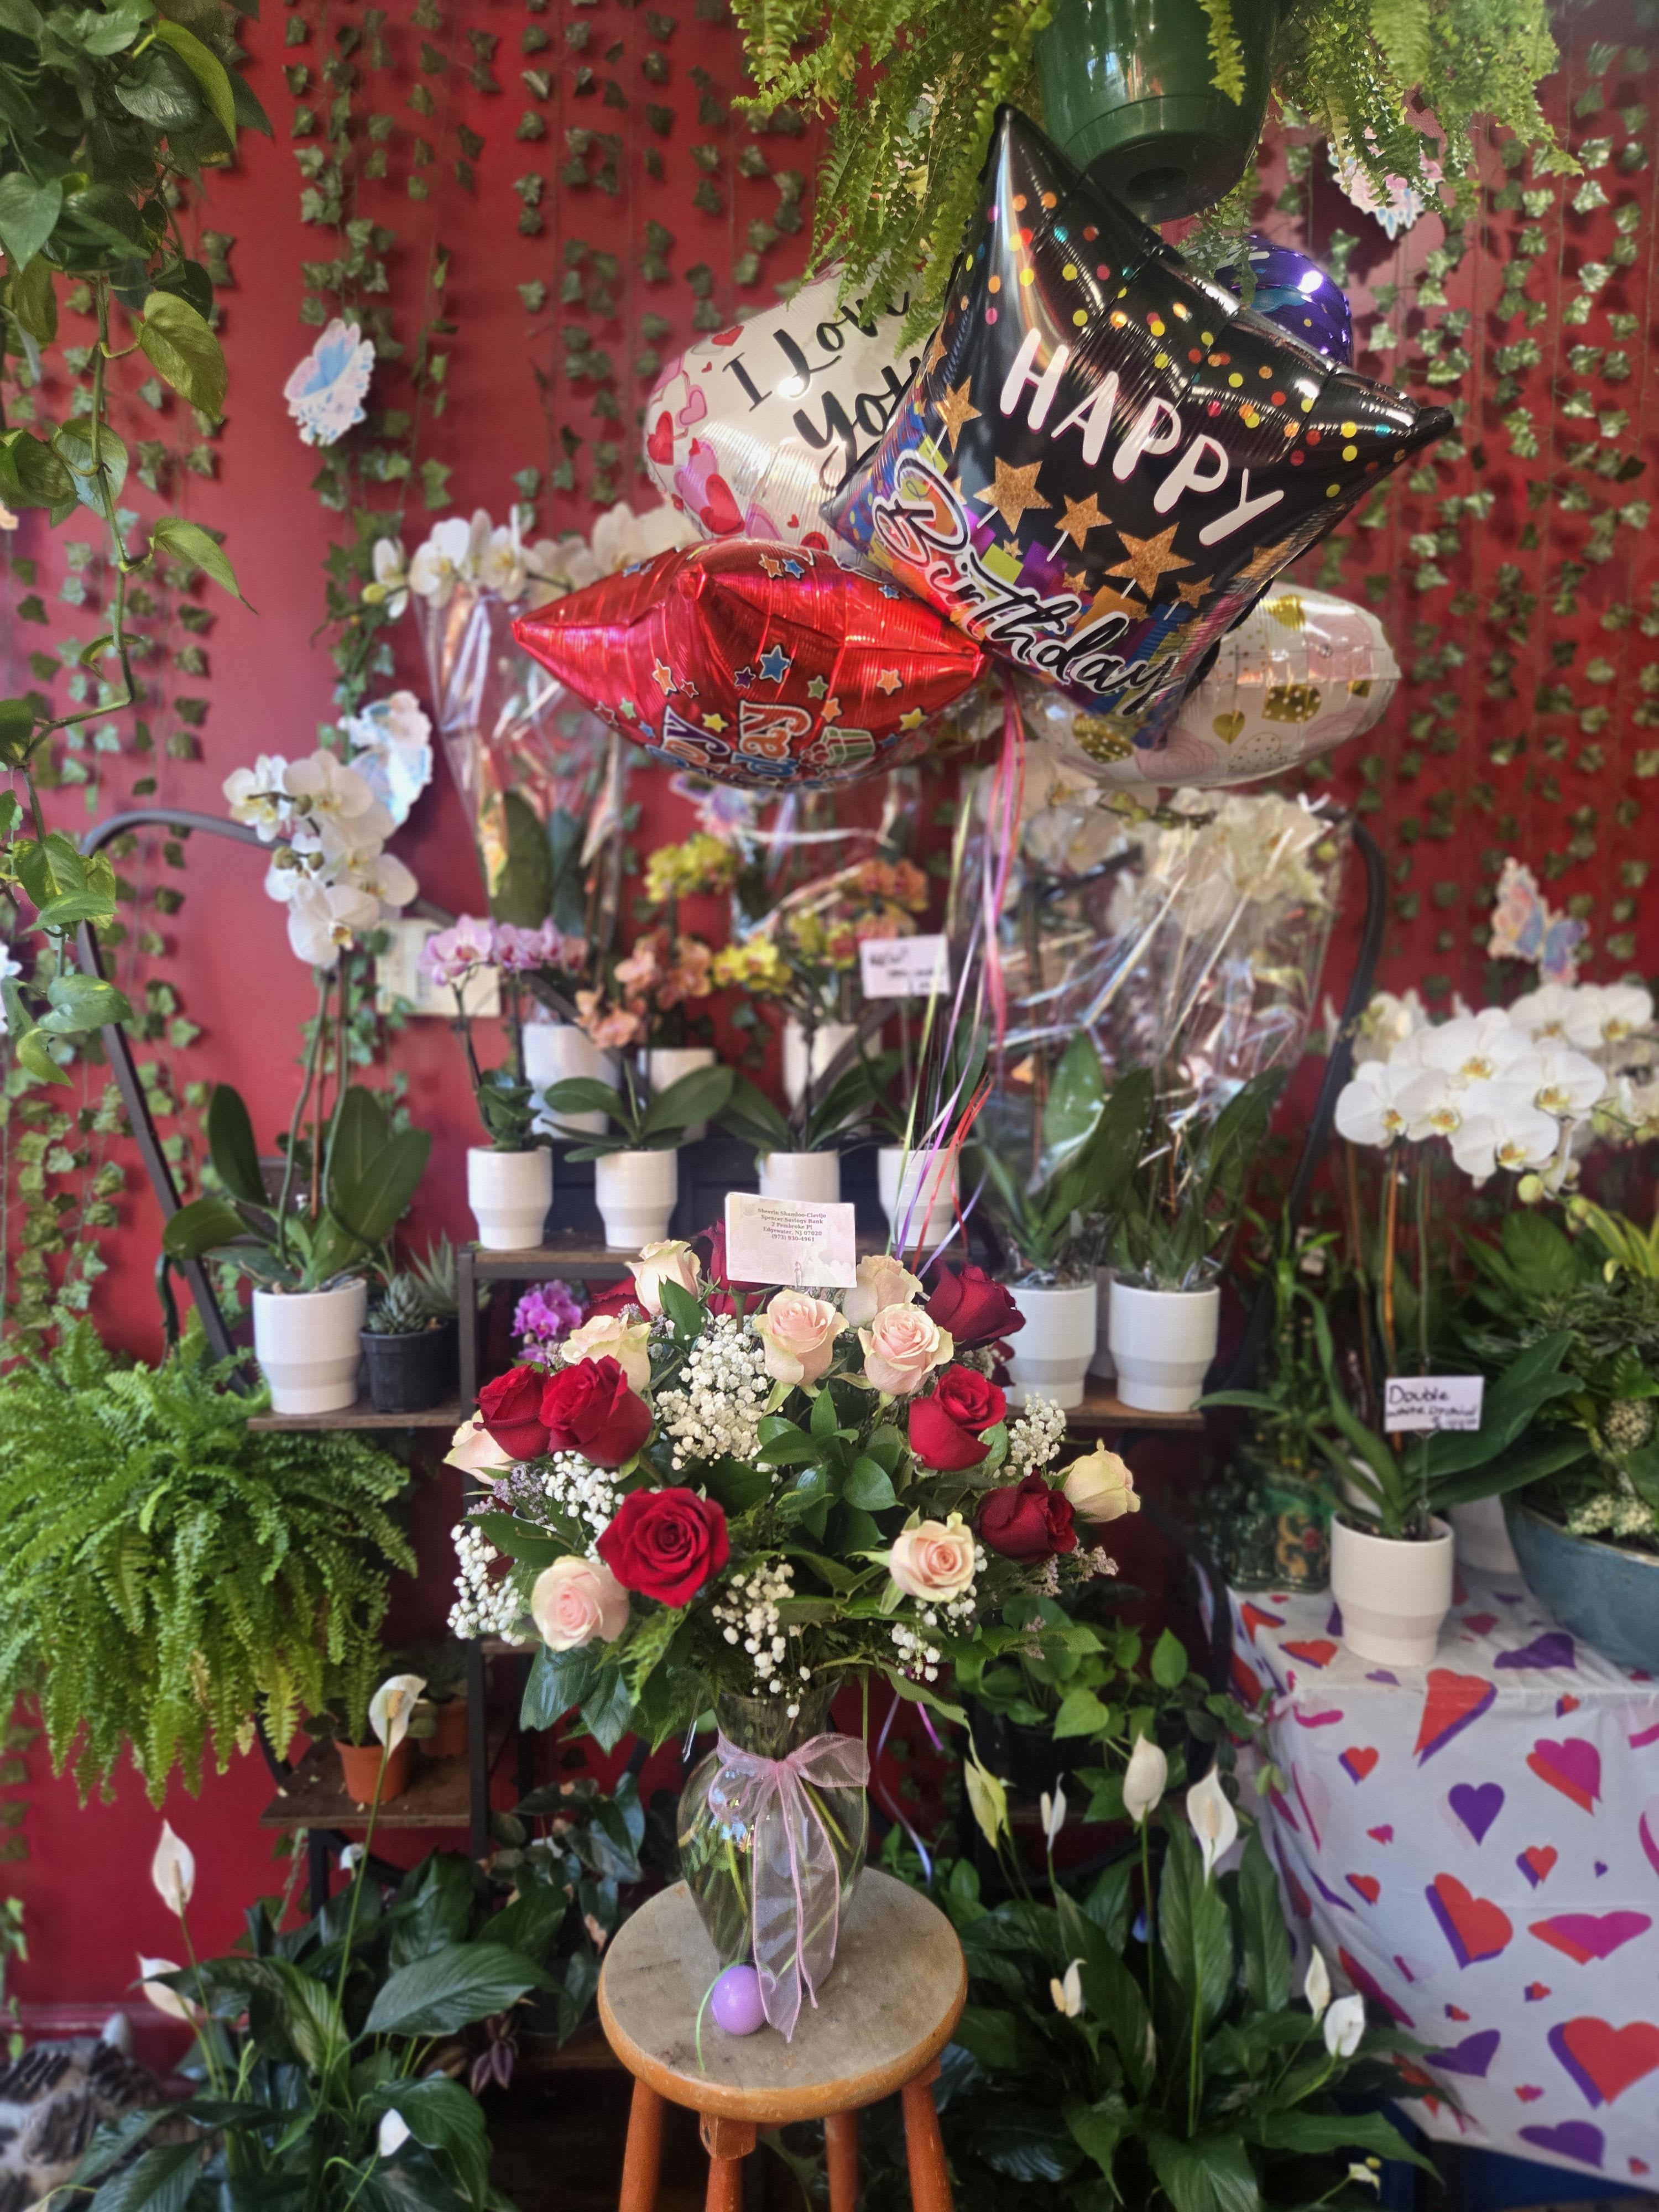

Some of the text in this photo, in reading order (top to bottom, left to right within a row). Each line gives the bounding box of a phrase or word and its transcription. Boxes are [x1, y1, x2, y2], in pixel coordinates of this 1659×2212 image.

[722, 291, 909, 412] I Lov
[1000, 328, 1285, 547] HAPPY
[873, 450, 1185, 717] Birthday
[763, 1227, 794, 1235] Edgewater,
[1389, 1384, 1449, 1405] Double
